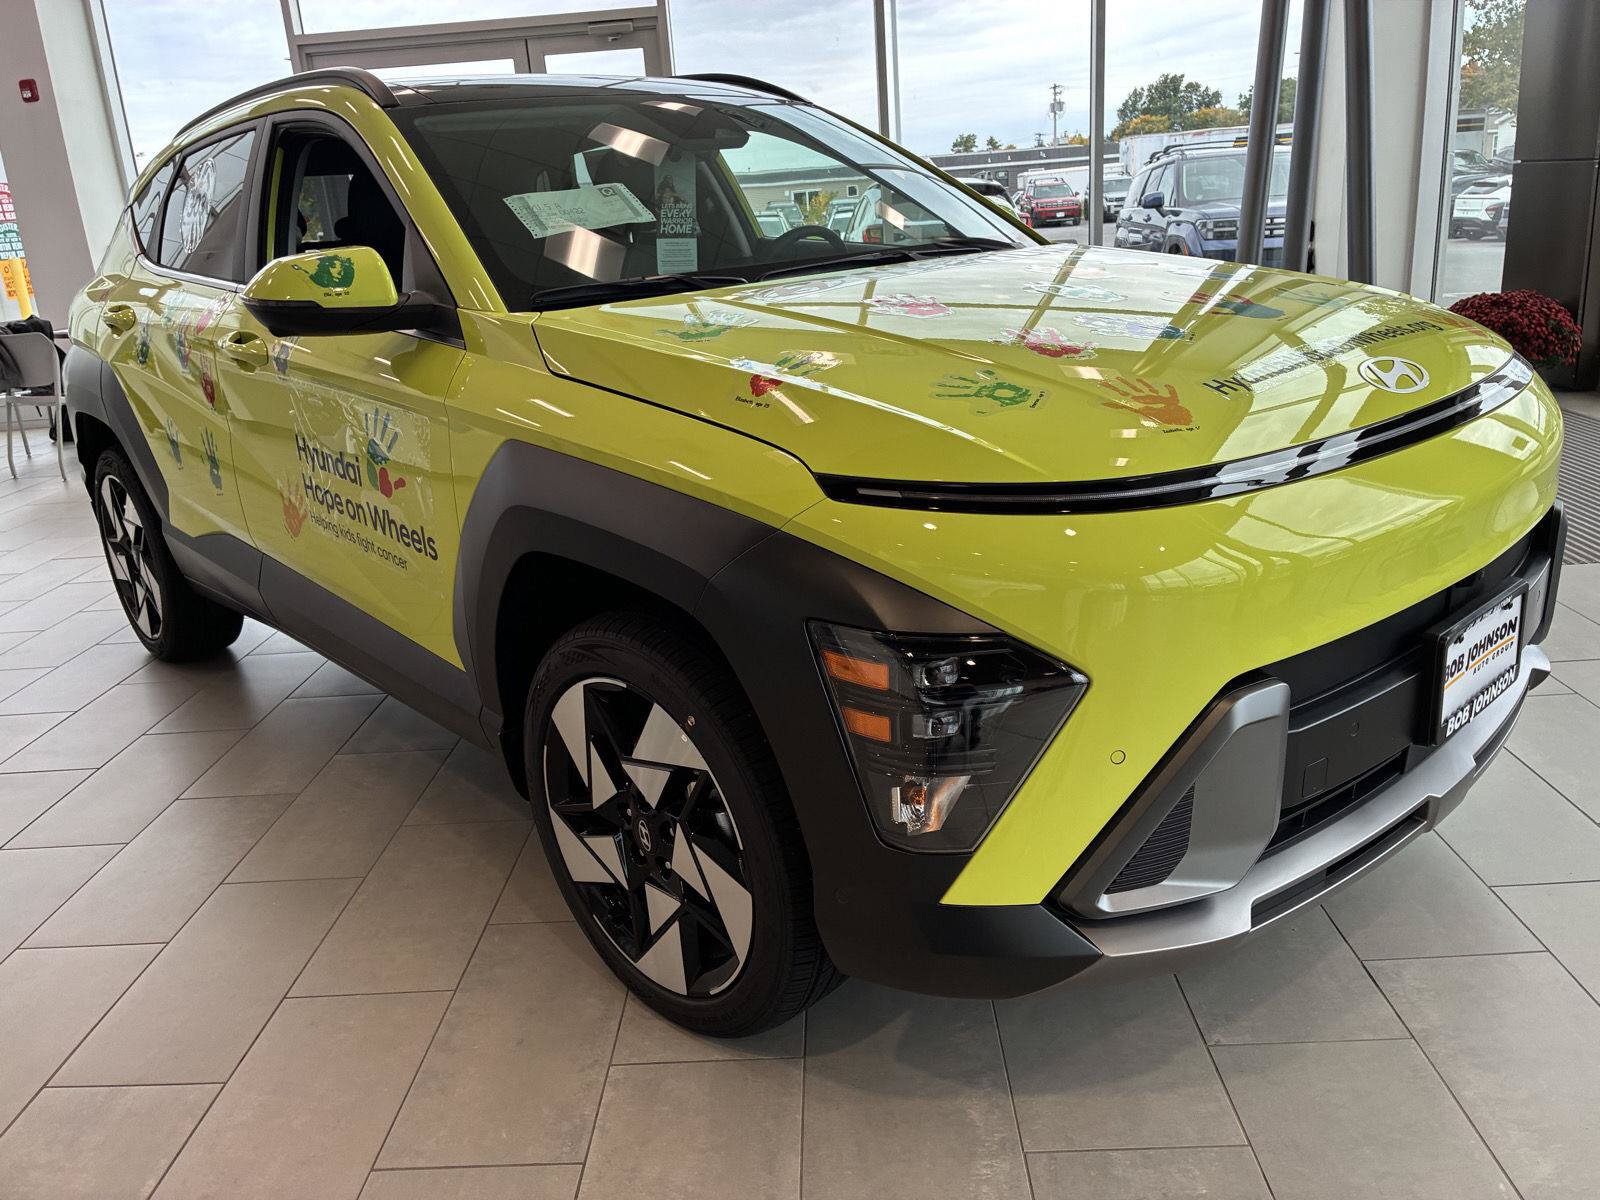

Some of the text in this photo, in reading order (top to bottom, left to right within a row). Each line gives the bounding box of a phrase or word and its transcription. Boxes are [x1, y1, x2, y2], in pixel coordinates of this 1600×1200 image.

[660, 208, 693, 218] EVERY
[660, 217, 694, 225] WARRIOR
[660, 224, 693, 234] HOME
[295, 433, 363, 487] Hyundai
[302, 472, 439, 561] Hope on Wheels
[310, 511, 339, 538] Helping
[339, 523, 357, 544] kids
[357, 533, 376, 553] fight
[377, 545, 408, 571] cancer
[1444, 616, 1518, 683] BOB JOHNSON
[1472, 641, 1514, 676] AUTO GROUP
[1445, 665, 1518, 738] BOB JOHNSON
